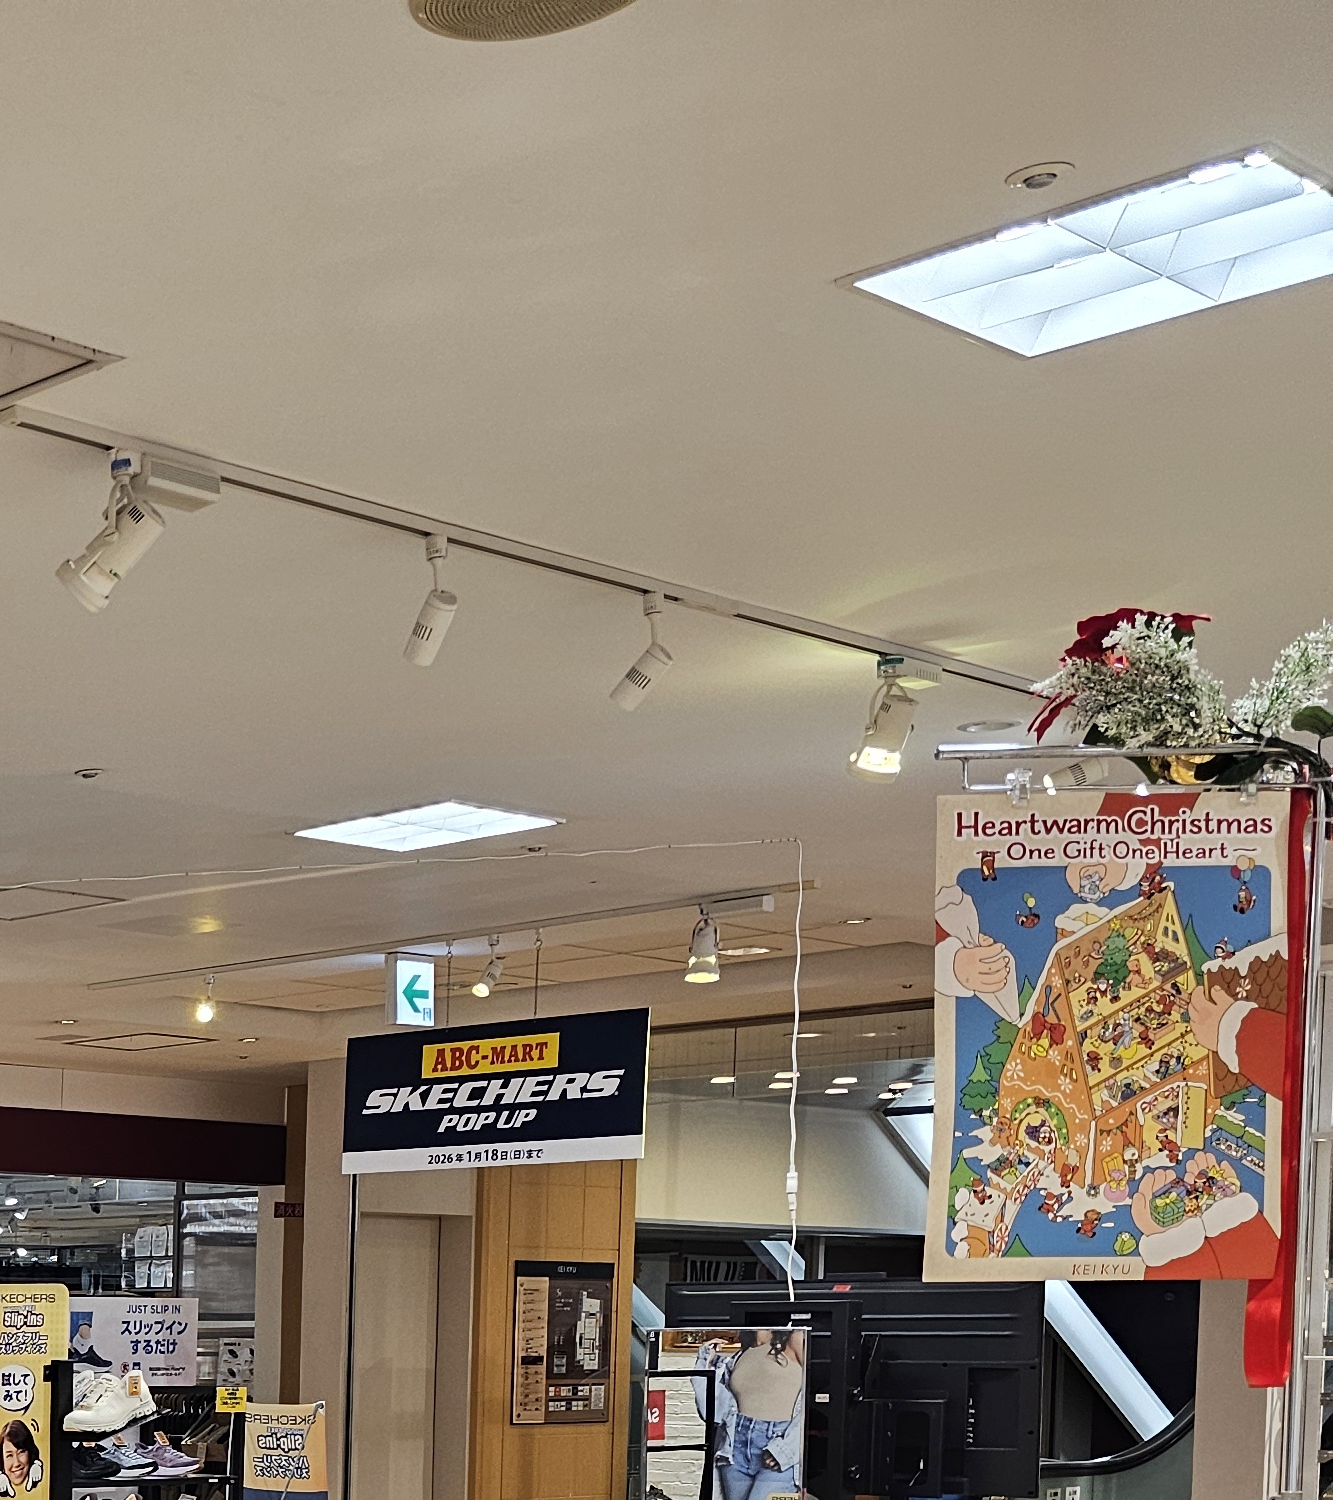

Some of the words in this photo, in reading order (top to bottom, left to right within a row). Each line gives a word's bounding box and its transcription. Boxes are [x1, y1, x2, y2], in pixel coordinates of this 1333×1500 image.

[955, 808, 1121, 838] Heartwarm
[1126, 804, 1273, 836] Christmas
[1006, 842, 1056, 860] One
[1063, 839, 1106, 861] Gift
[1113, 841, 1156, 859] One
[1161, 839, 1229, 860] Heart
[431, 1041, 548, 1073] ABC-MART
[362, 1069, 625, 1114] SKECHERS
[437, 1112, 496, 1133] POP
[496, 1108, 538, 1130] UP
[428, 1149, 544, 1165] 2026年1月18日(日)まで
[126, 1304, 147, 1314] JUST
[150, 1304, 169, 1314] SLIP
[171, 1304, 182, 1314] IN
[3, 1311, 44, 1329] Slip-ins
[121, 1319, 188, 1336] スリップイン
[130, 1338, 178, 1356] するだけ
[1, 1372, 31, 1387] 試して
[3, 1388, 29, 1402] みて!
